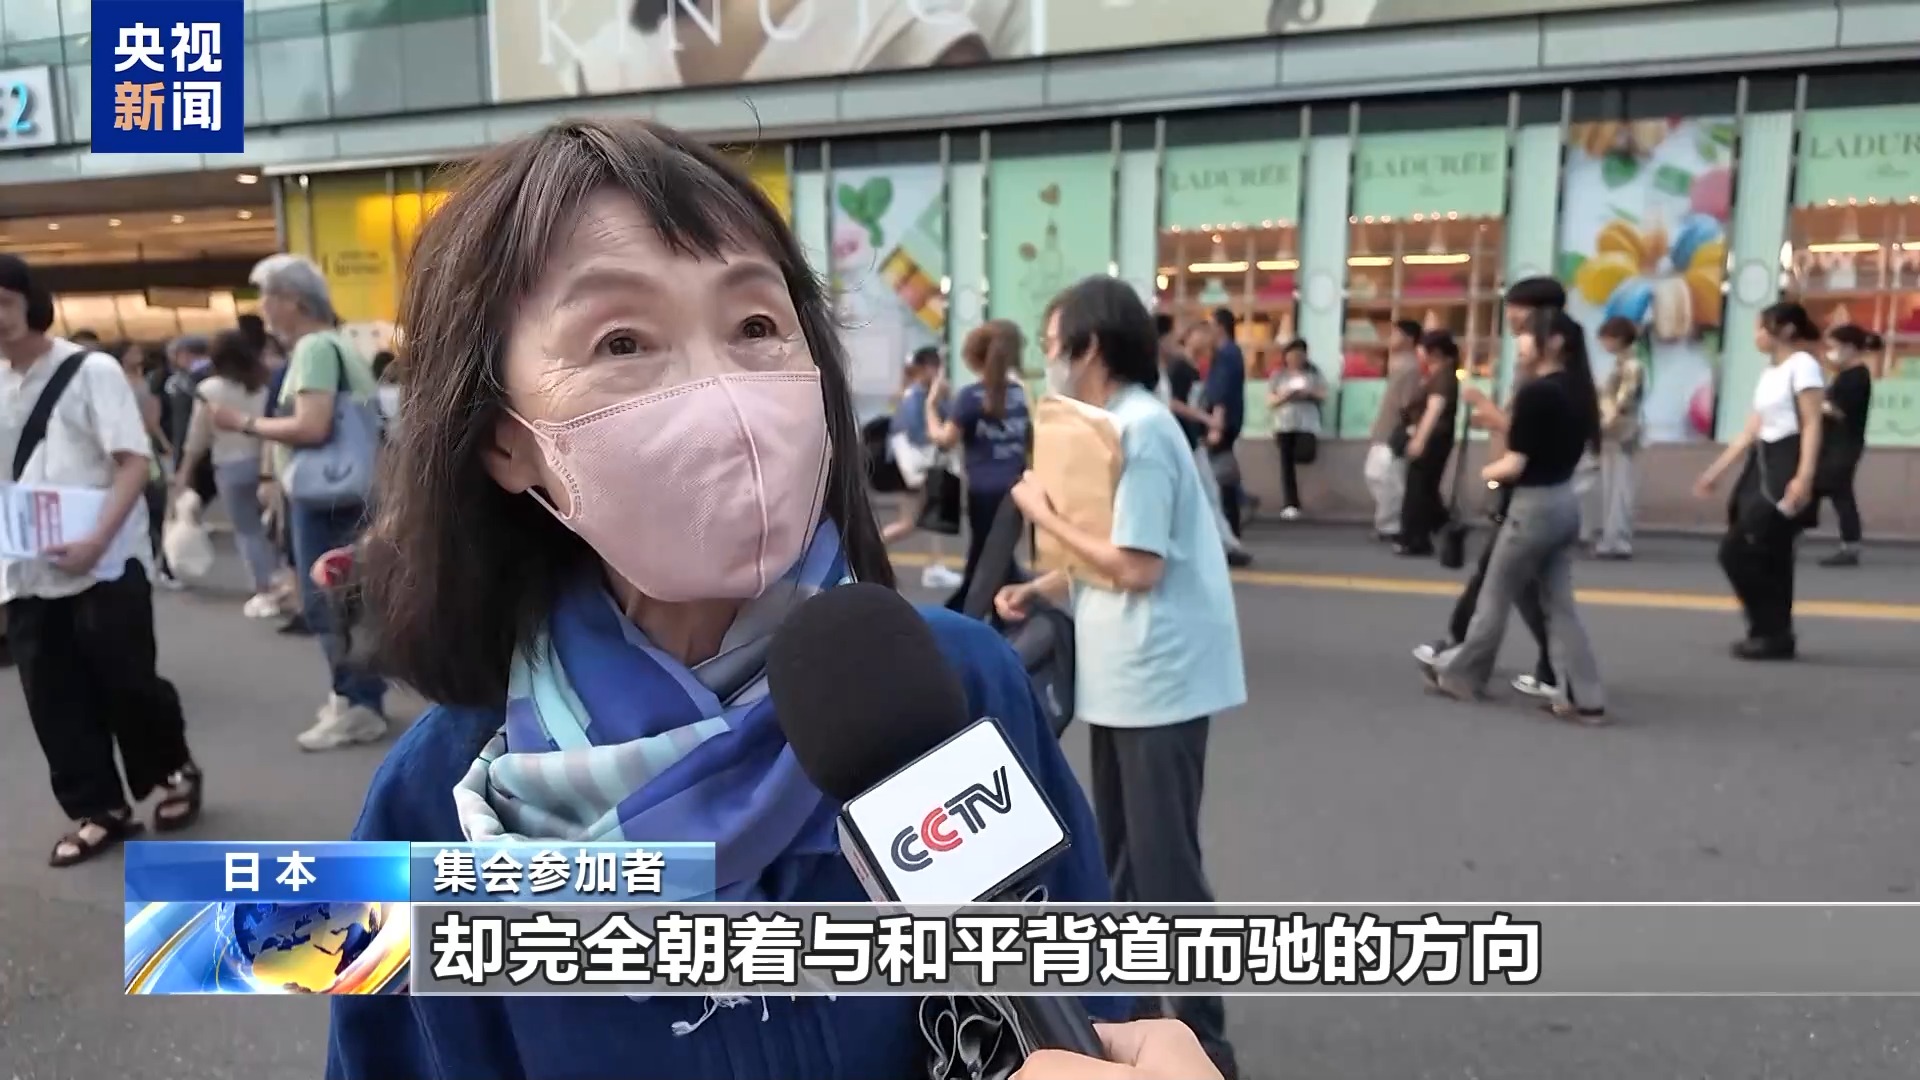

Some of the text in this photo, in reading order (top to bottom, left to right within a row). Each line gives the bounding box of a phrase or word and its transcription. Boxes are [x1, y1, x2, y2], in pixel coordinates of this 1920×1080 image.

[538, 0, 980, 66] KINU
[8, 80, 34, 135] 2
[891, 765, 1011, 872] CCTV
